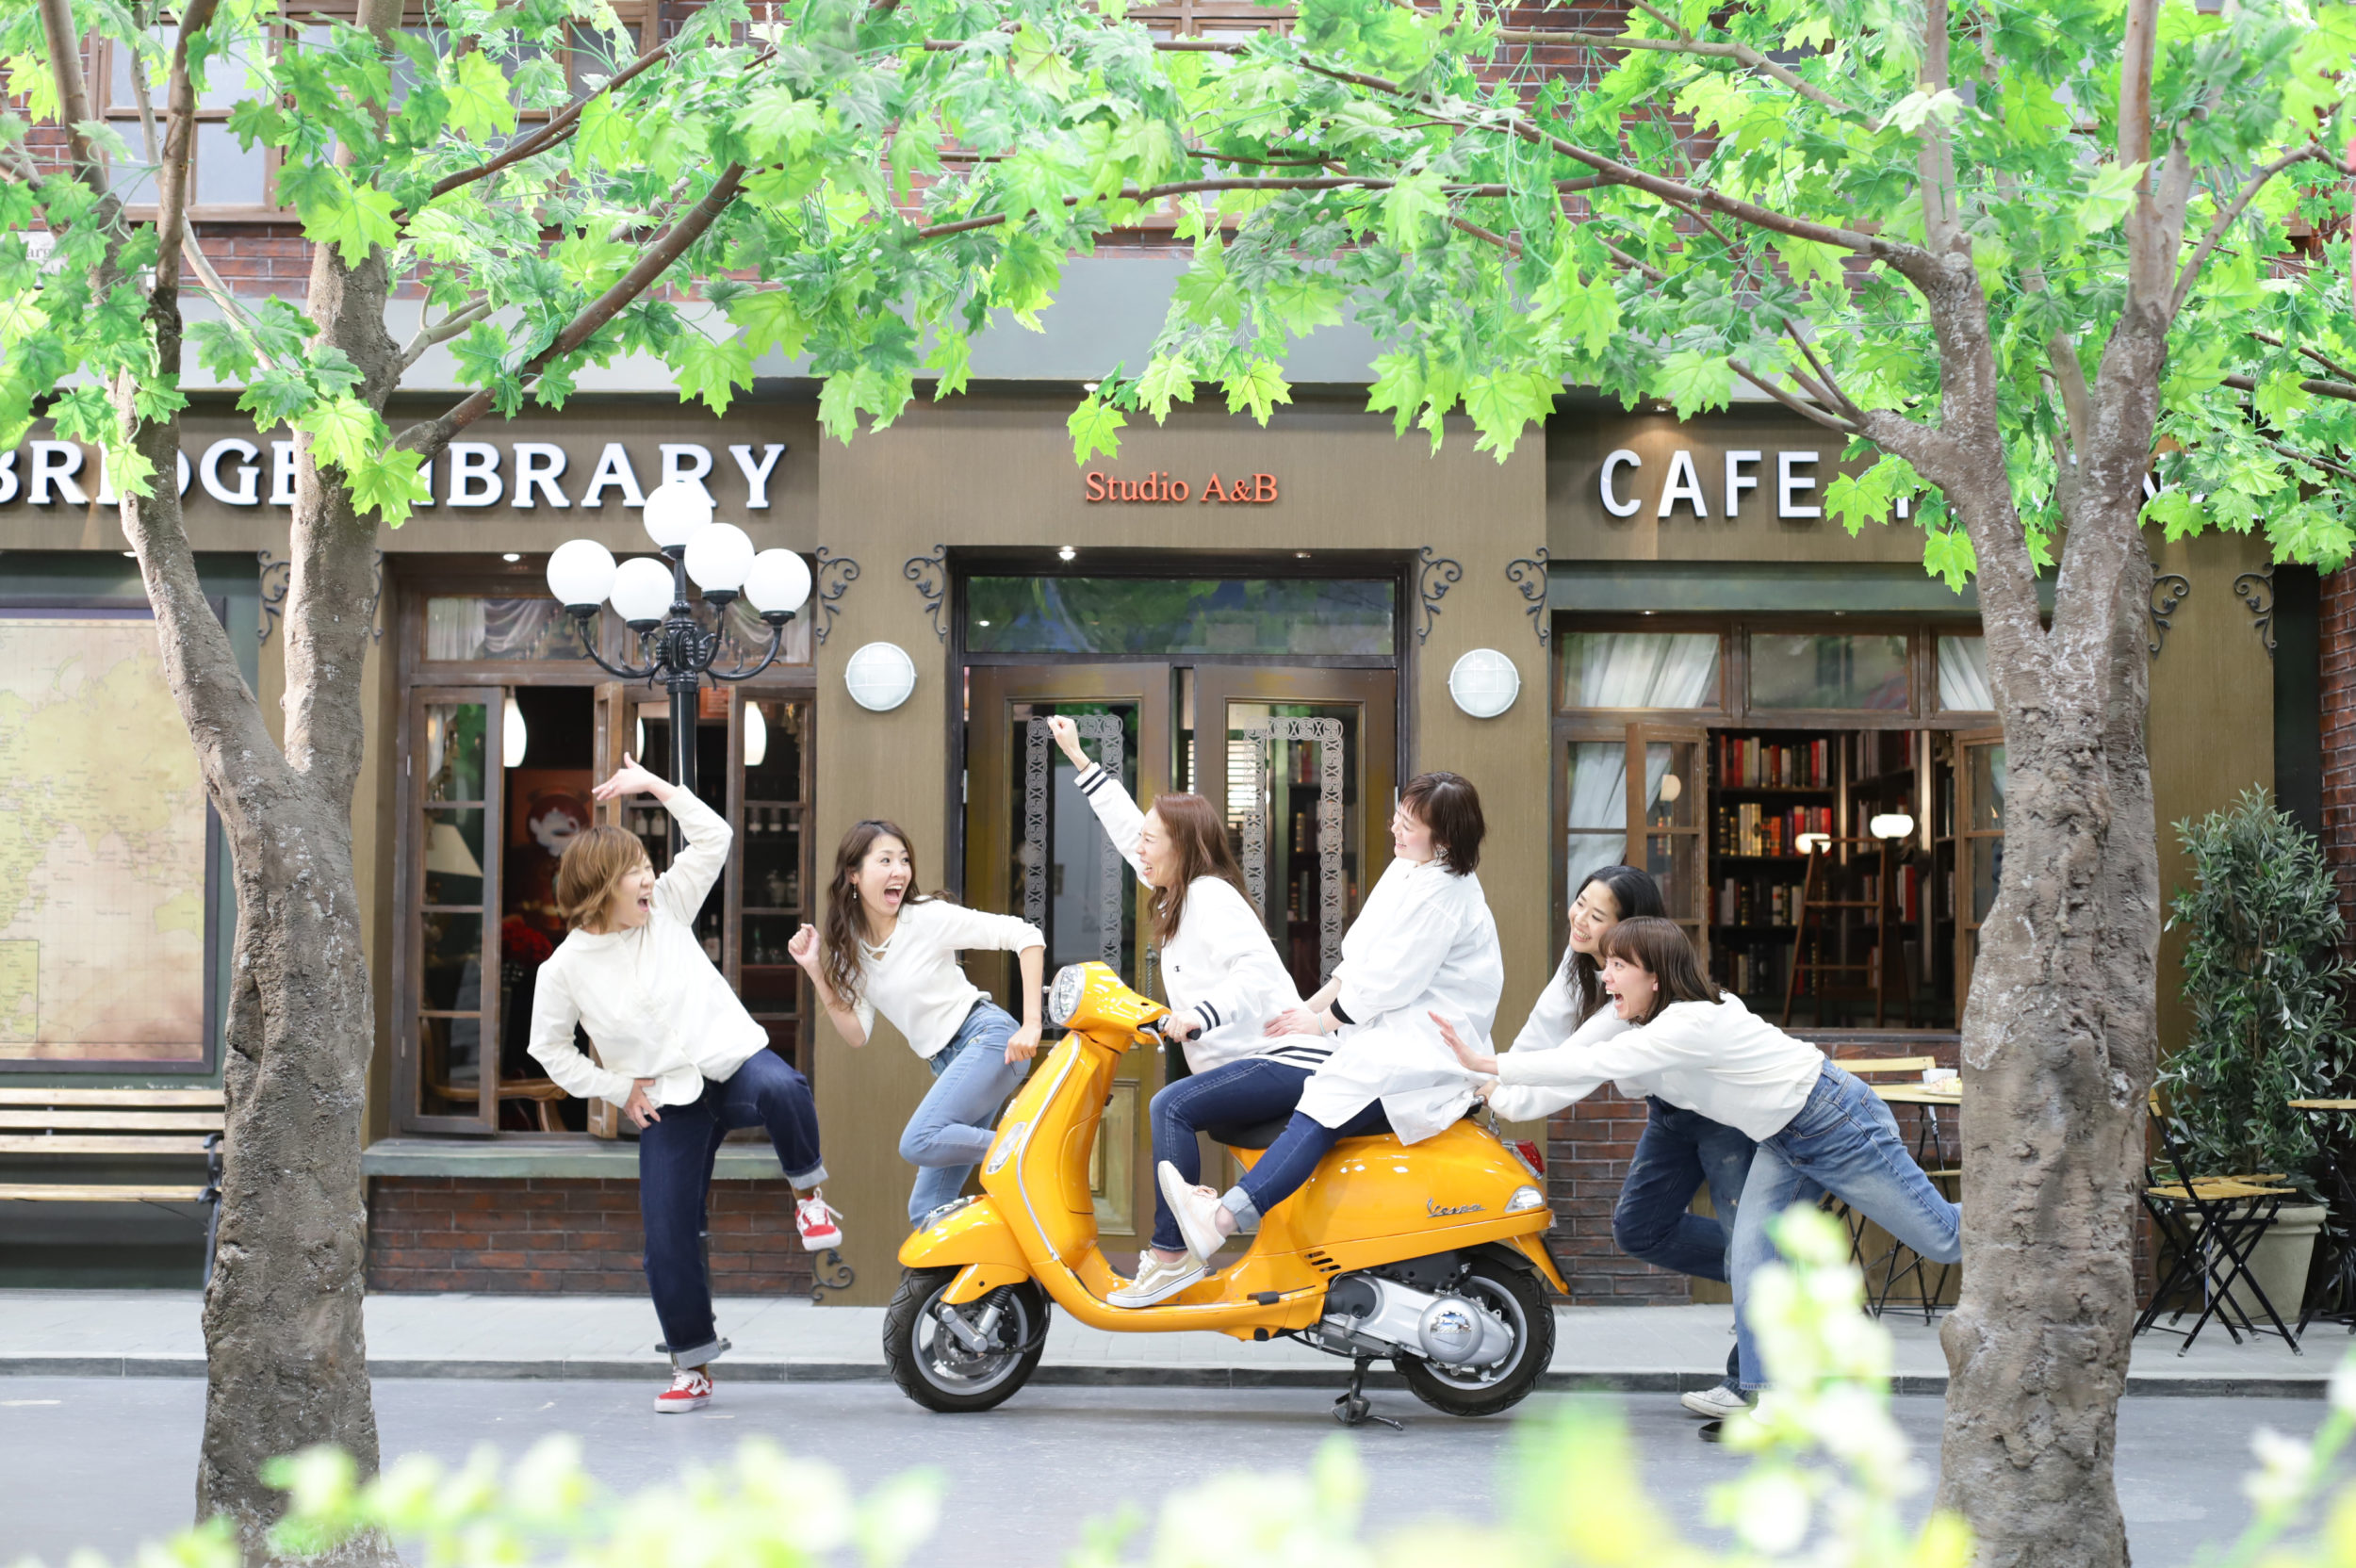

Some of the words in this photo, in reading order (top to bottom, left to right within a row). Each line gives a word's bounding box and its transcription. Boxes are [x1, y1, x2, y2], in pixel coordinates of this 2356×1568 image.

[1086, 471, 1190, 502] Studio
[1200, 472, 1279, 503] A&B
[1599, 449, 1822, 518] CAFE
[1427, 1197, 1486, 1217] Vespa
